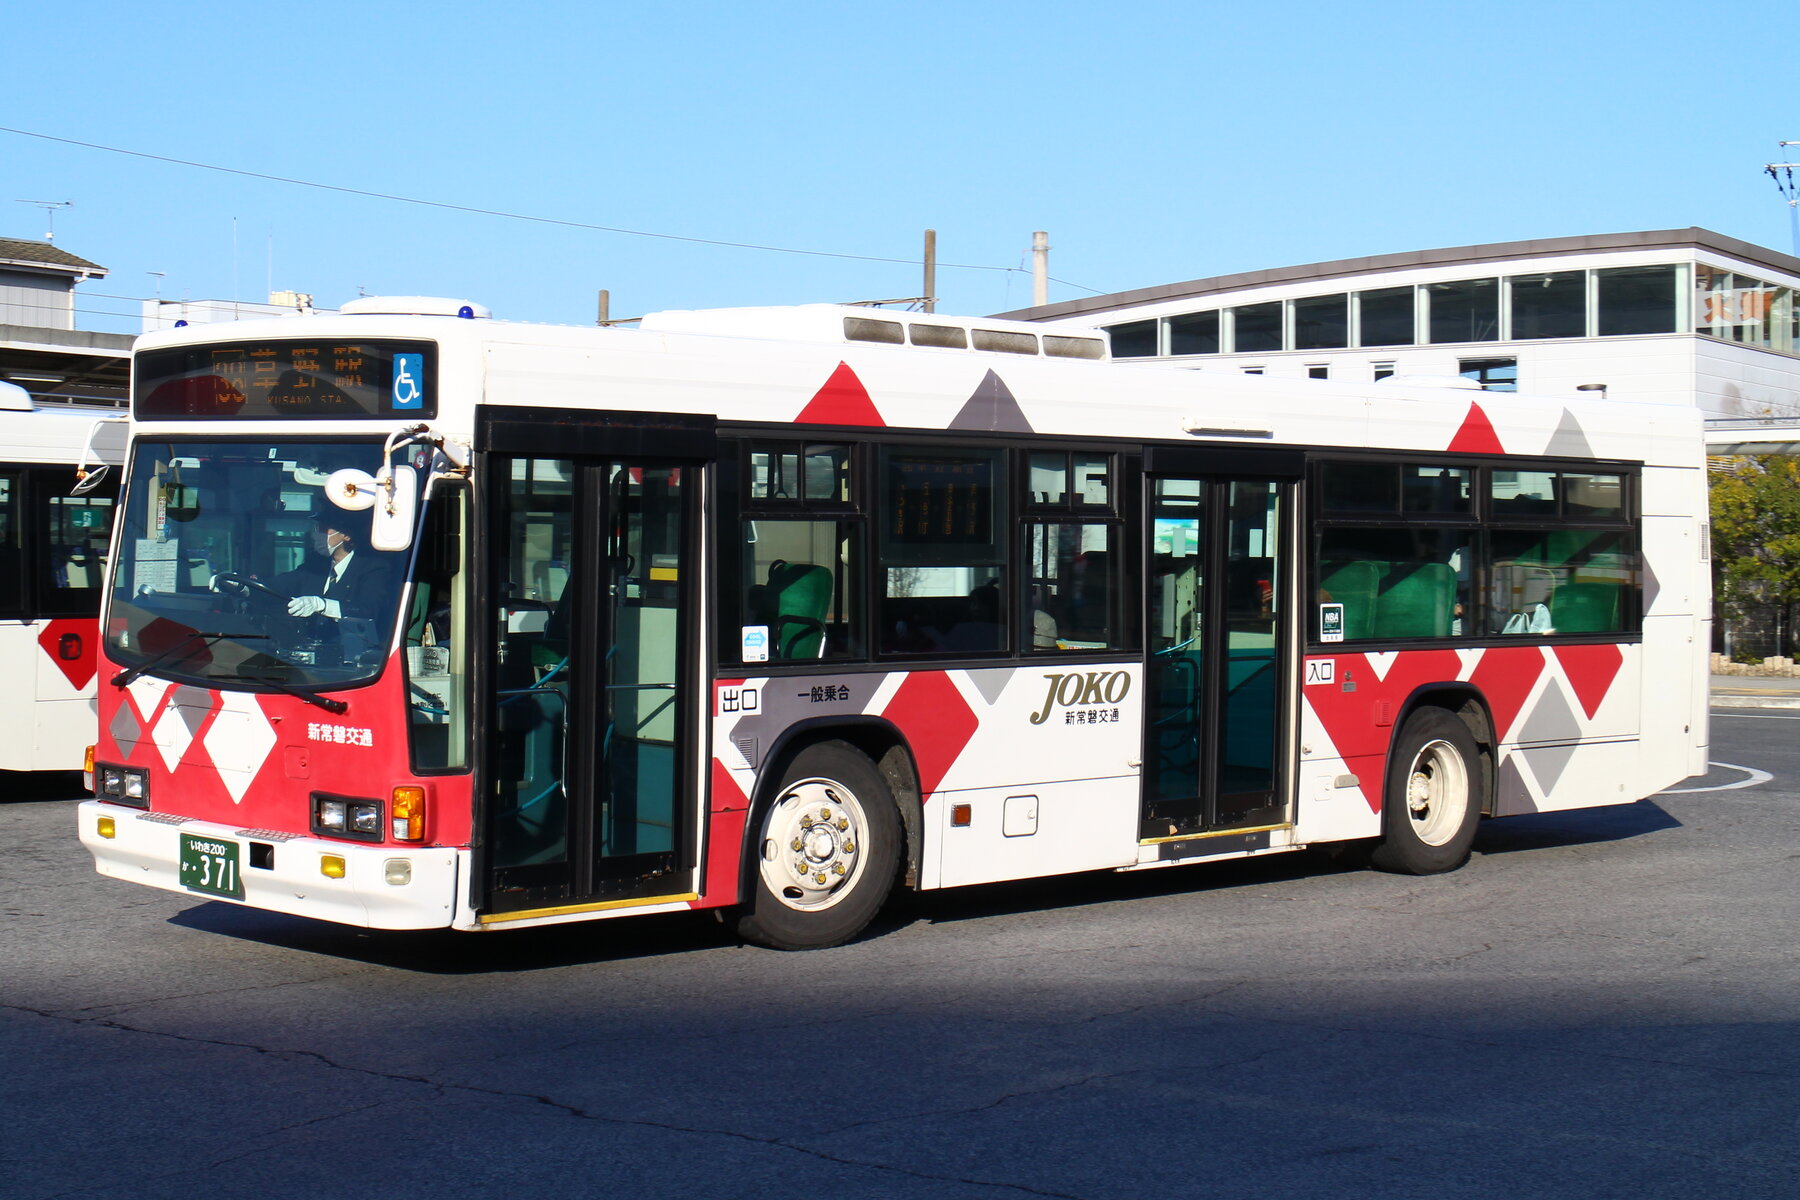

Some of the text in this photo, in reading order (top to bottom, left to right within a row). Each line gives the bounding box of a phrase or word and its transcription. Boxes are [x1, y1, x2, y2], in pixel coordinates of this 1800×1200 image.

[1308, 662, 1332, 682] 入口
[723, 688, 757, 712] 出口
[797, 685, 850, 703] 一般乗合
[1030, 670, 1131, 725] JOKO
[1065, 708, 1119, 725] 新常磐交通
[308, 722, 373, 747] 新常磐交通
[190, 840, 226, 856] いわき200
